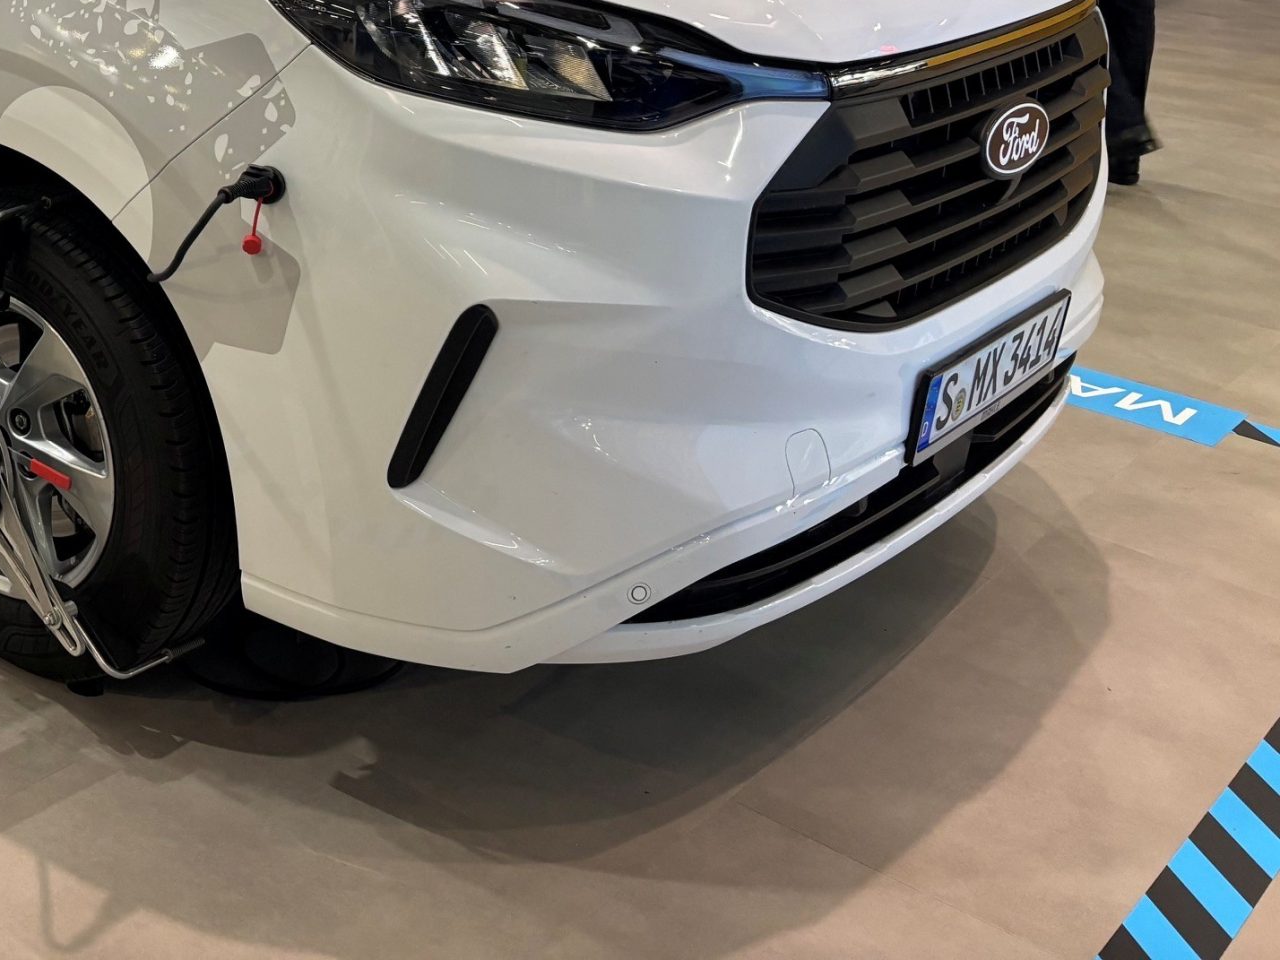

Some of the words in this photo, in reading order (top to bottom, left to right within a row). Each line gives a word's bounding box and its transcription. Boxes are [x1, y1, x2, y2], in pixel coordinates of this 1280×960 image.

[999, 112, 1040, 166] Ford
[935, 372, 959, 431] S
[966, 341, 1007, 412] MX
[1003, 306, 1063, 387] 3414
[1069, 374, 1198, 426] MA
